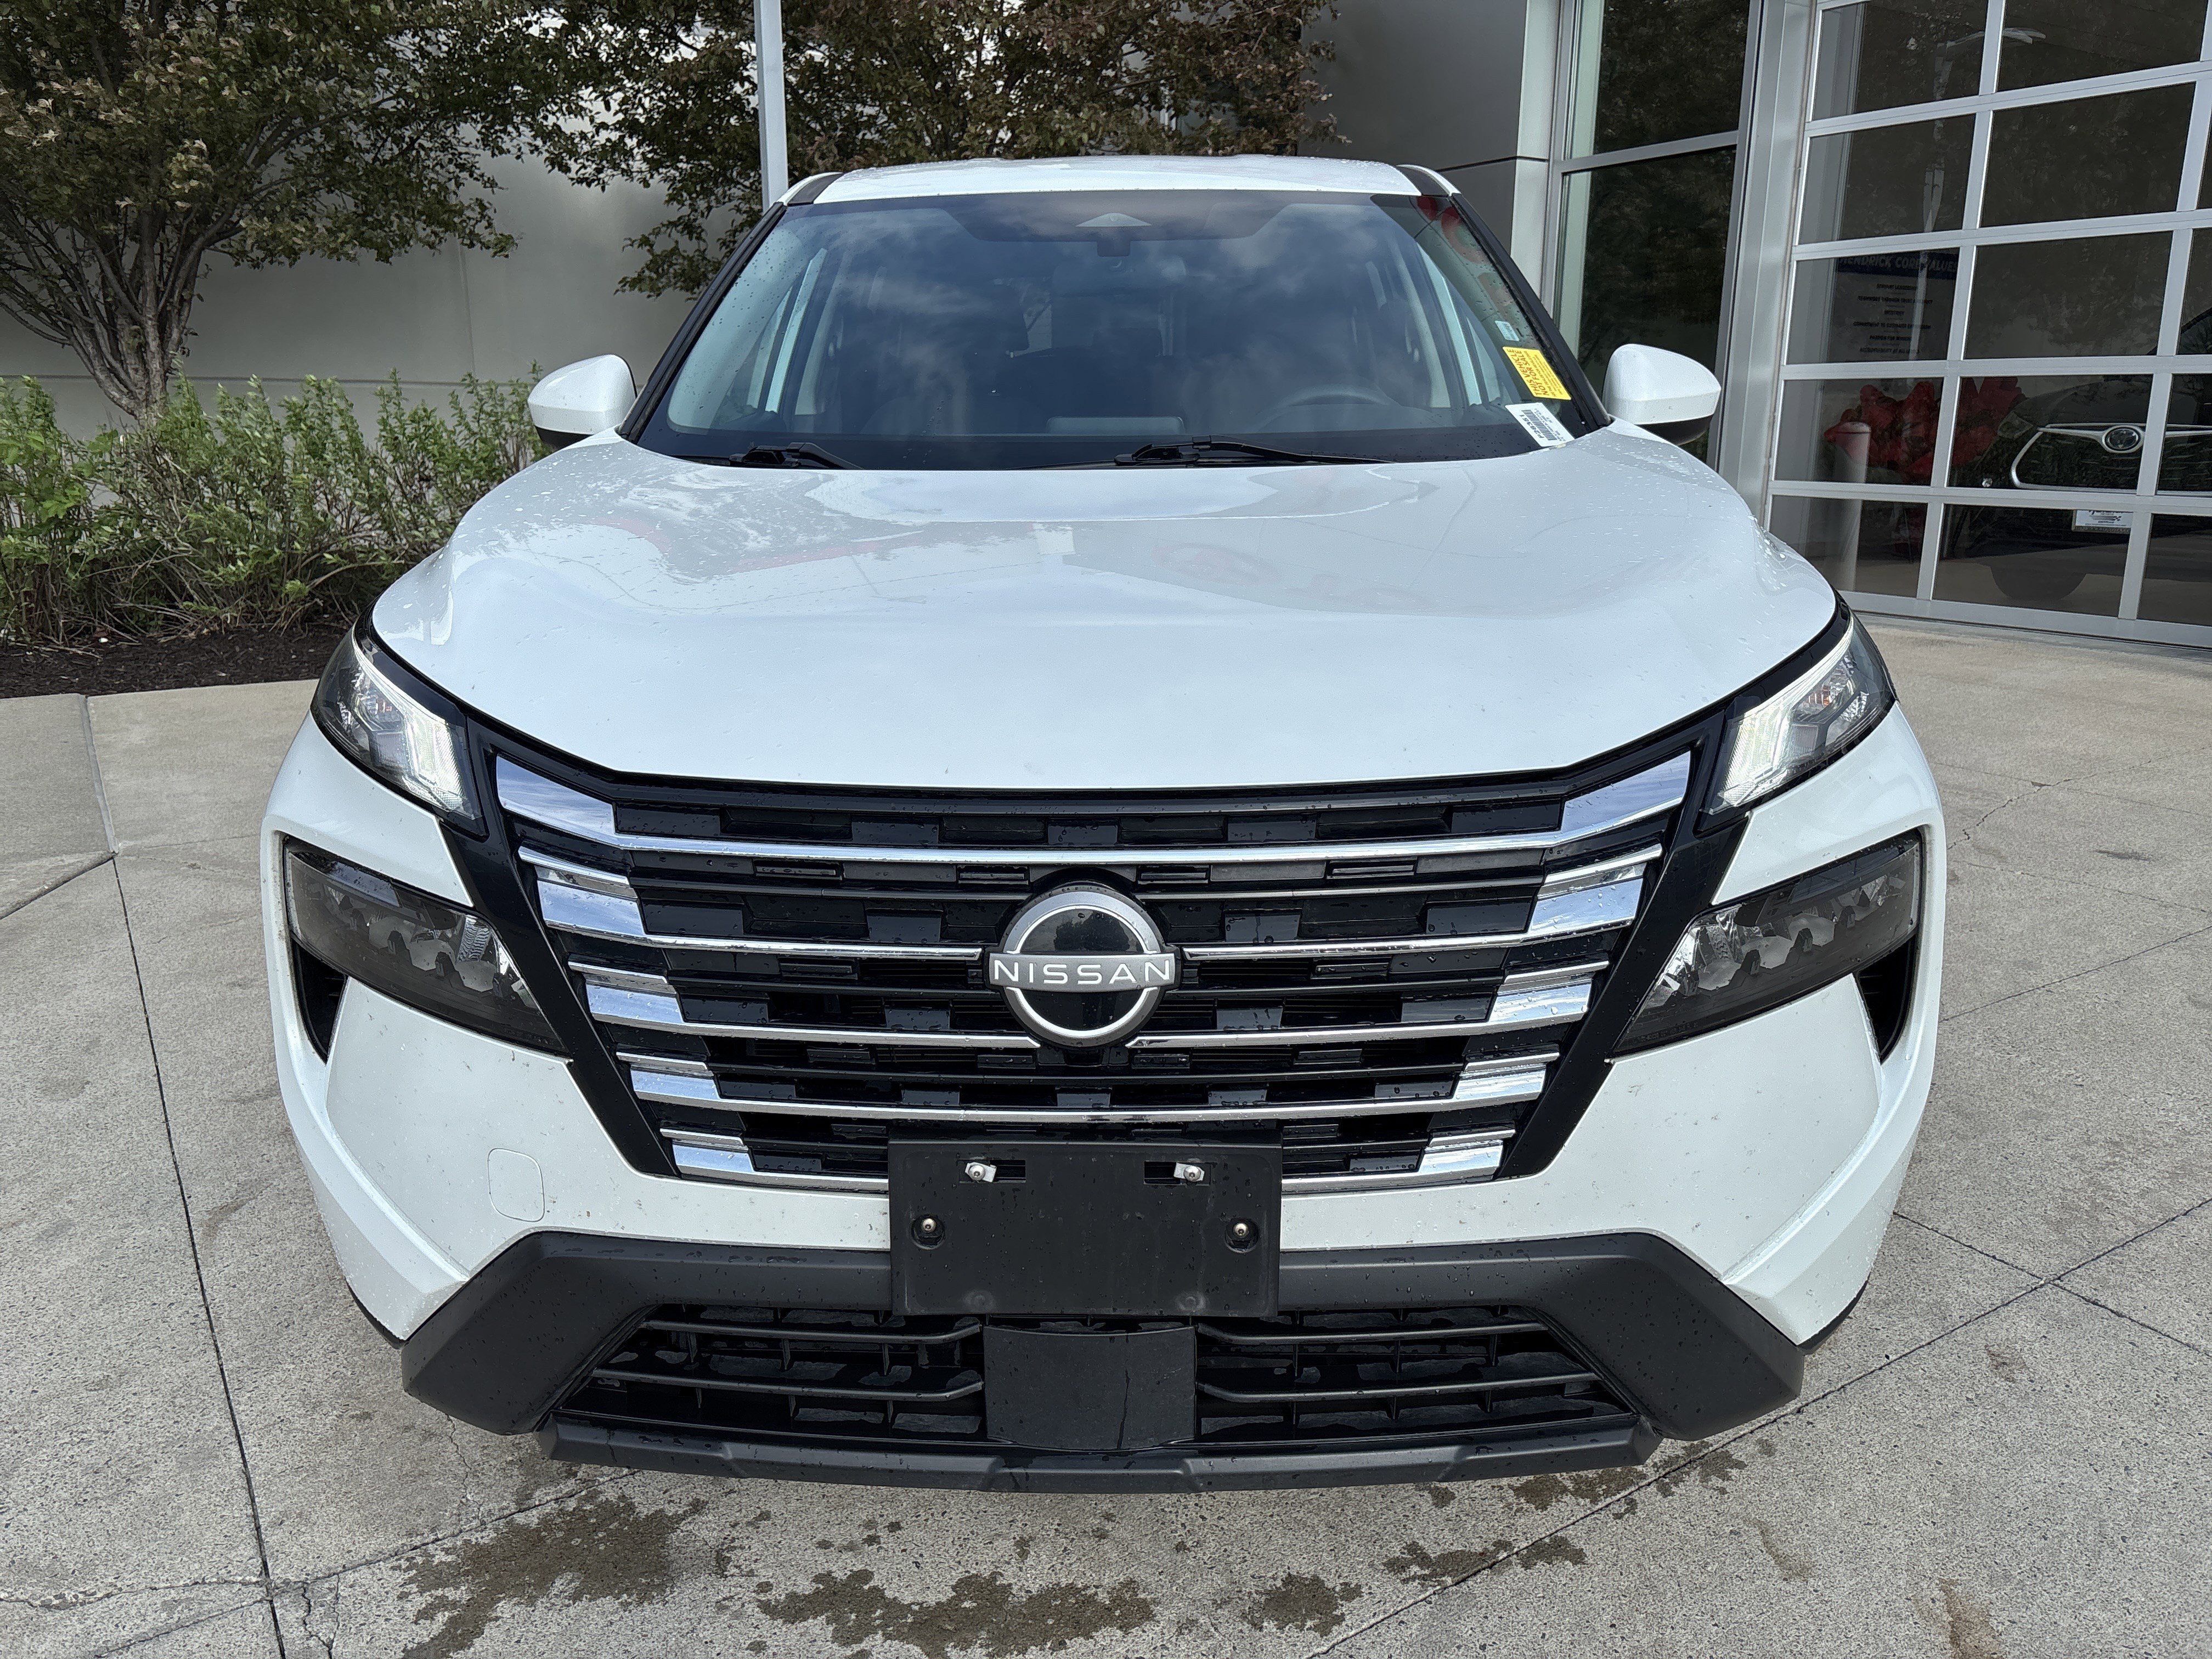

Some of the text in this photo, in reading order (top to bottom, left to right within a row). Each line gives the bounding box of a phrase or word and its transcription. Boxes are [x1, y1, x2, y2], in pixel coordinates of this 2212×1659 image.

[1506, 349, 1531, 378] VEHICLE
[1514, 350, 1530, 366] SALE
[1525, 367, 1539, 380] FOR
[1527, 379, 1543, 396] THIS
[1535, 381, 1550, 396] NOT
[994, 960, 1170, 985] NISSAN
